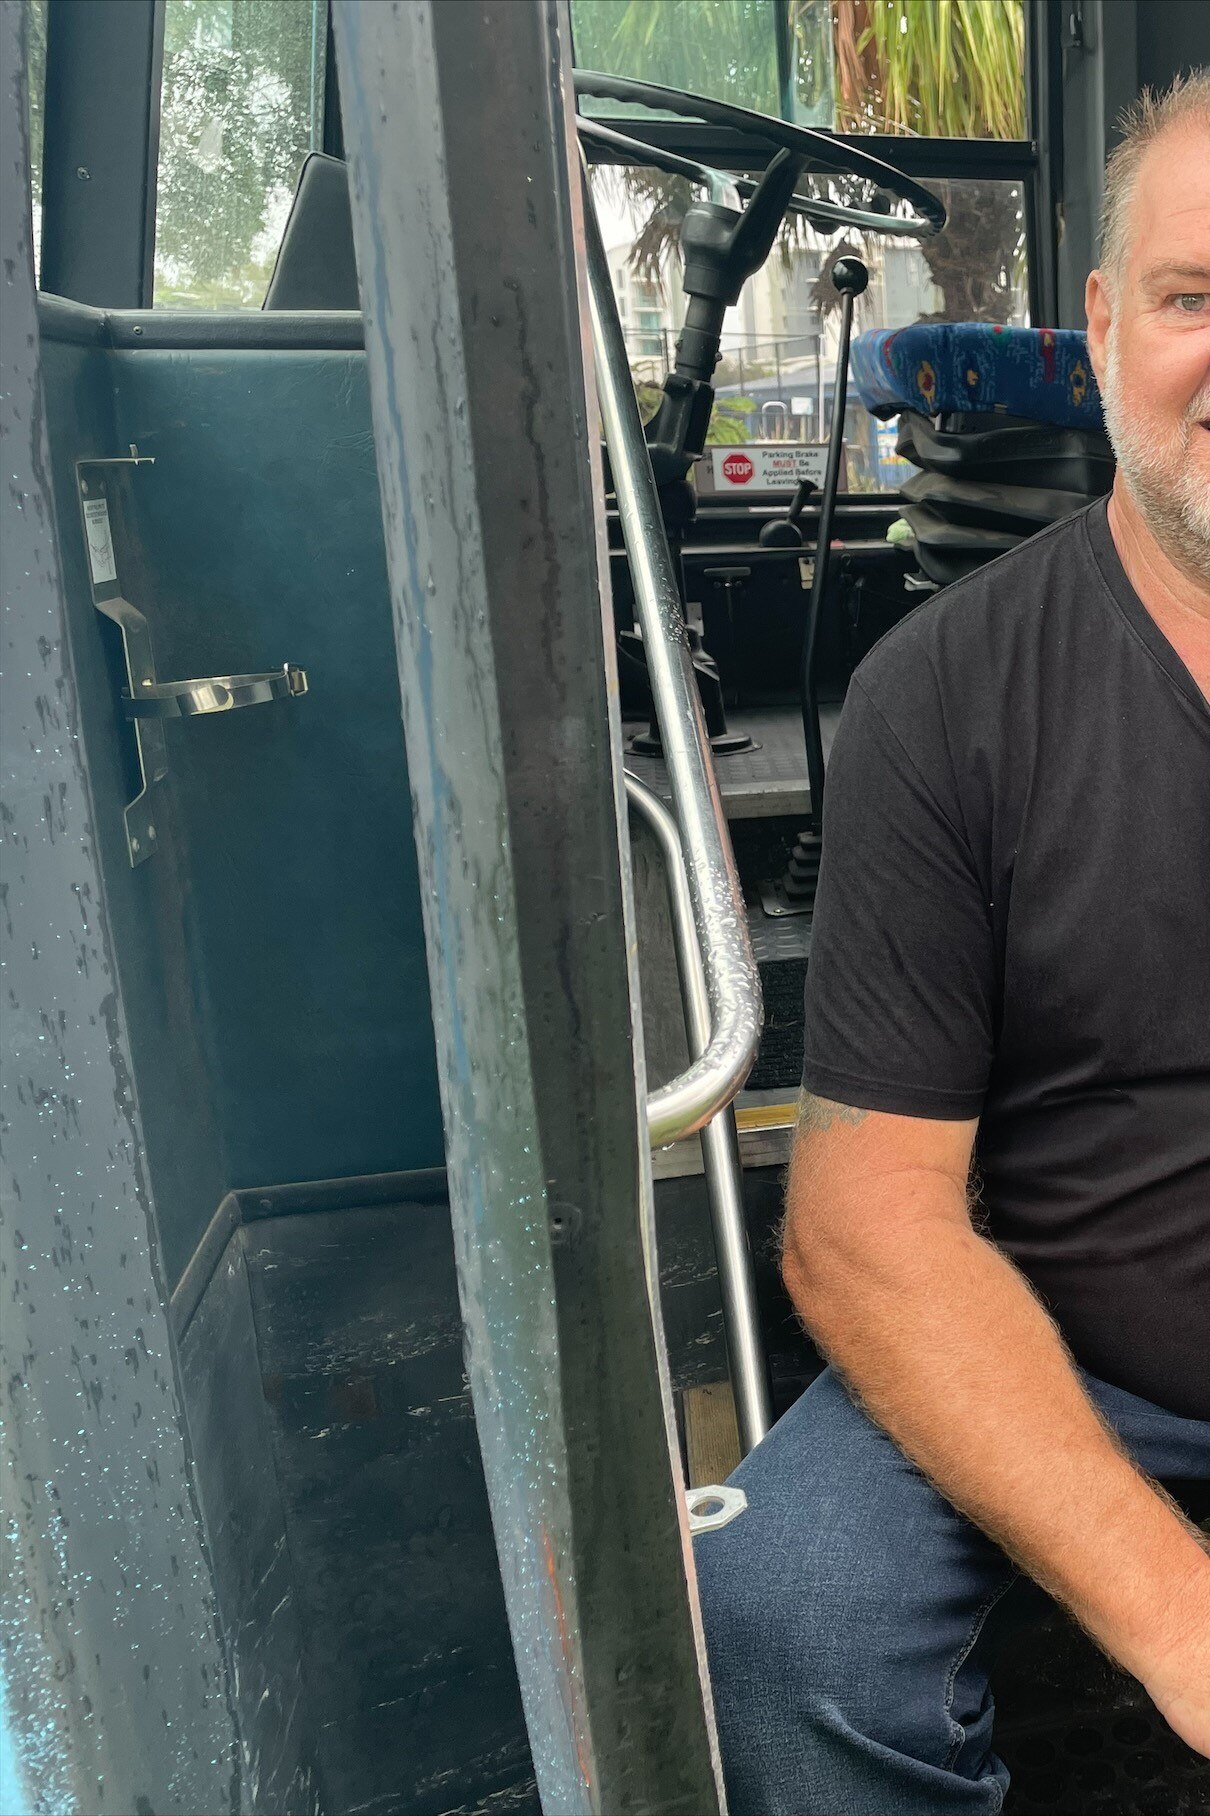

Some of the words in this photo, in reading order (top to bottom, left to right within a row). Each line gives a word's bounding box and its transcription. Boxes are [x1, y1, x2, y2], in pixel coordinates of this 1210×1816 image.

[762, 451, 794, 459] Parking
[795, 450, 818, 458] Brake
[724, 463, 752, 475] STOP
[762, 469, 793, 477] Applied
